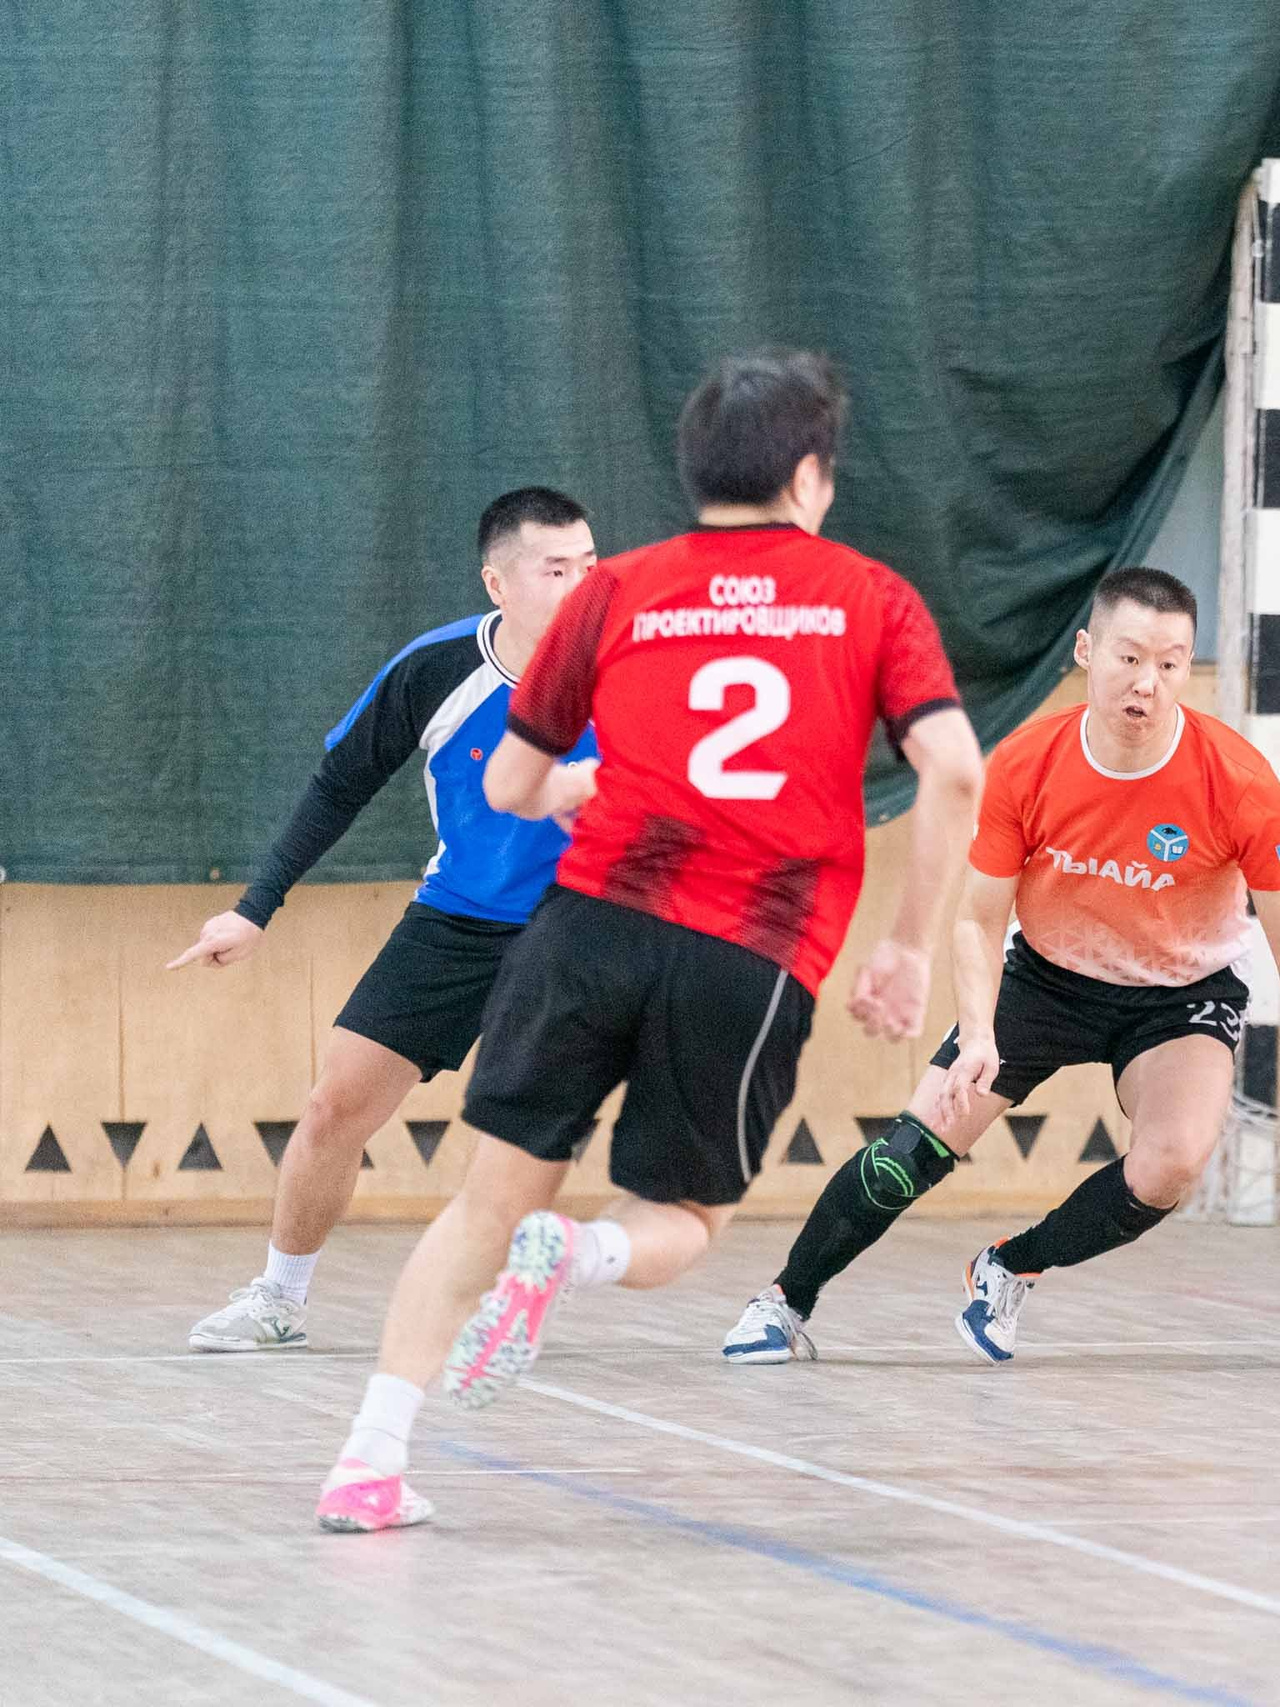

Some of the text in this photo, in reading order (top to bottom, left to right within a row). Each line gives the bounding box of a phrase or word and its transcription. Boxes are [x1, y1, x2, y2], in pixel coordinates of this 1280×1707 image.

[709, 575, 776, 605] СОЮЗ
[632, 606, 846, 642] ПРОЕКТИРОВЩИКОВ
[688, 657, 791, 800] 2
[1046, 847, 1175, 891] ТЫАЙА
[1187, 1001, 1240, 1041] 23
